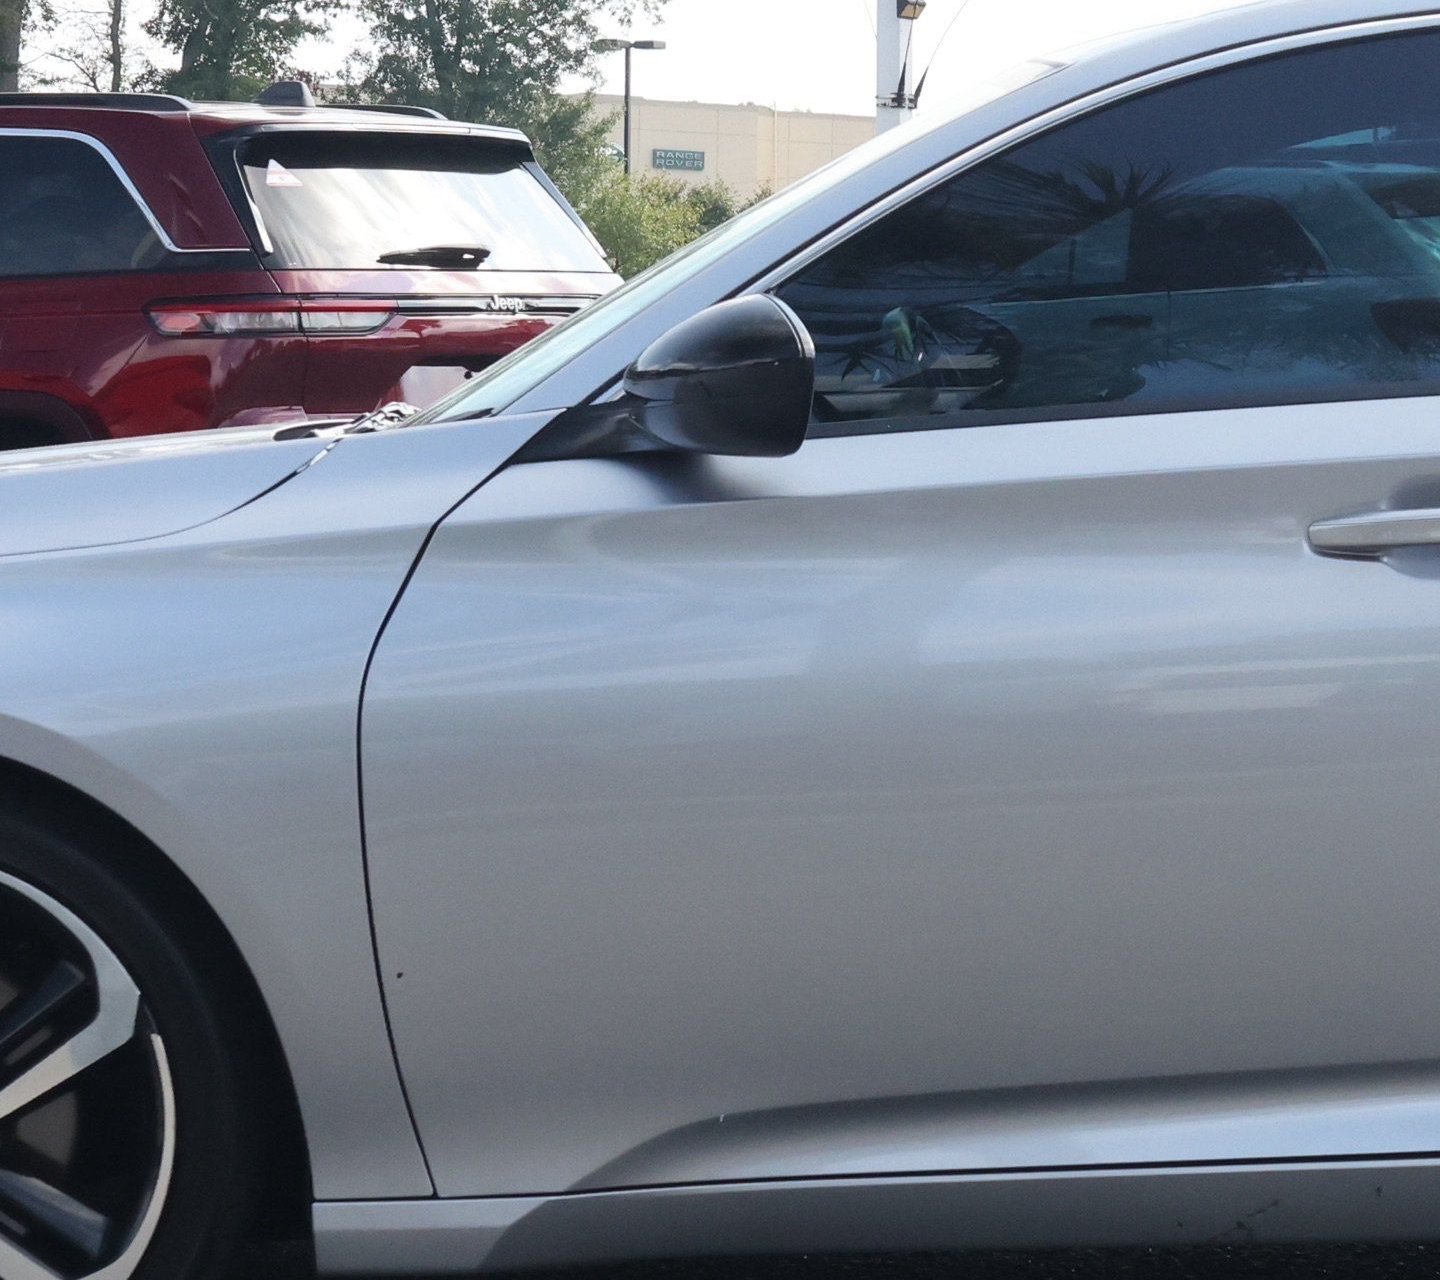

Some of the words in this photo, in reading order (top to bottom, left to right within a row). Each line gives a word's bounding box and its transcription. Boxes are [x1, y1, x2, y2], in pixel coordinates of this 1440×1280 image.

[656, 151, 703, 159] RANGE
[656, 159, 704, 167] ROVER
[490, 295, 523, 313] Jeep
